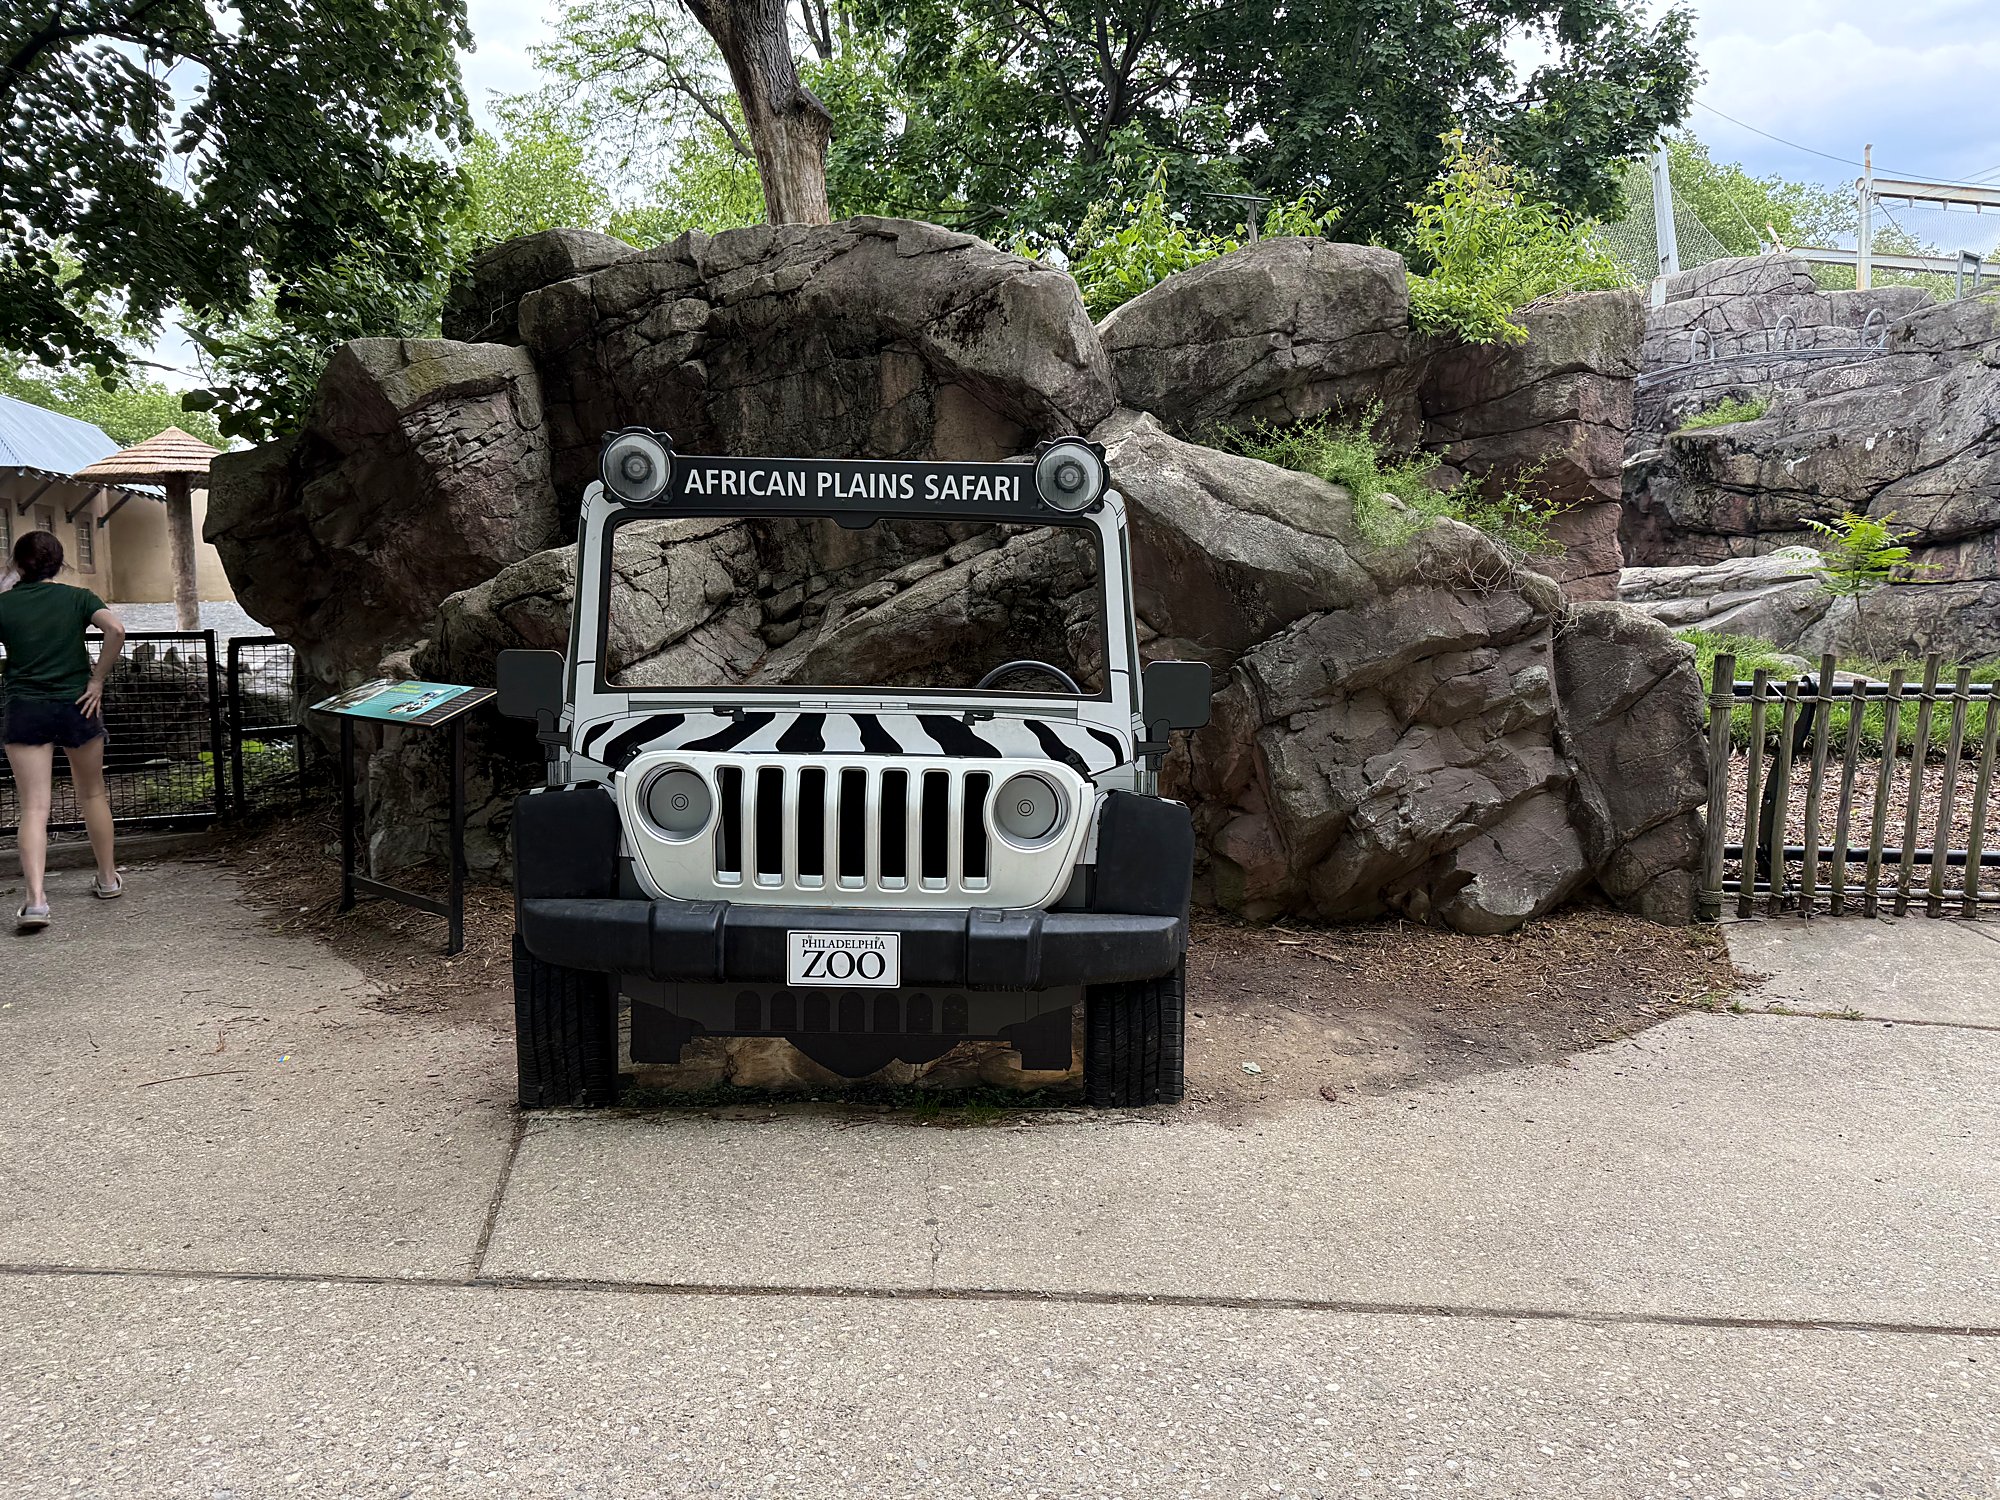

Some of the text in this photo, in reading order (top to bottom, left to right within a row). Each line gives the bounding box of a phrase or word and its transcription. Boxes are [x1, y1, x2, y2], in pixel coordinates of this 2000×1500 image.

[684, 468, 1020, 502] AFRICAN PLAINS SAFARI
[802, 938, 886, 950] PHILADELPHIA
[801, 949, 886, 980] ZOO
